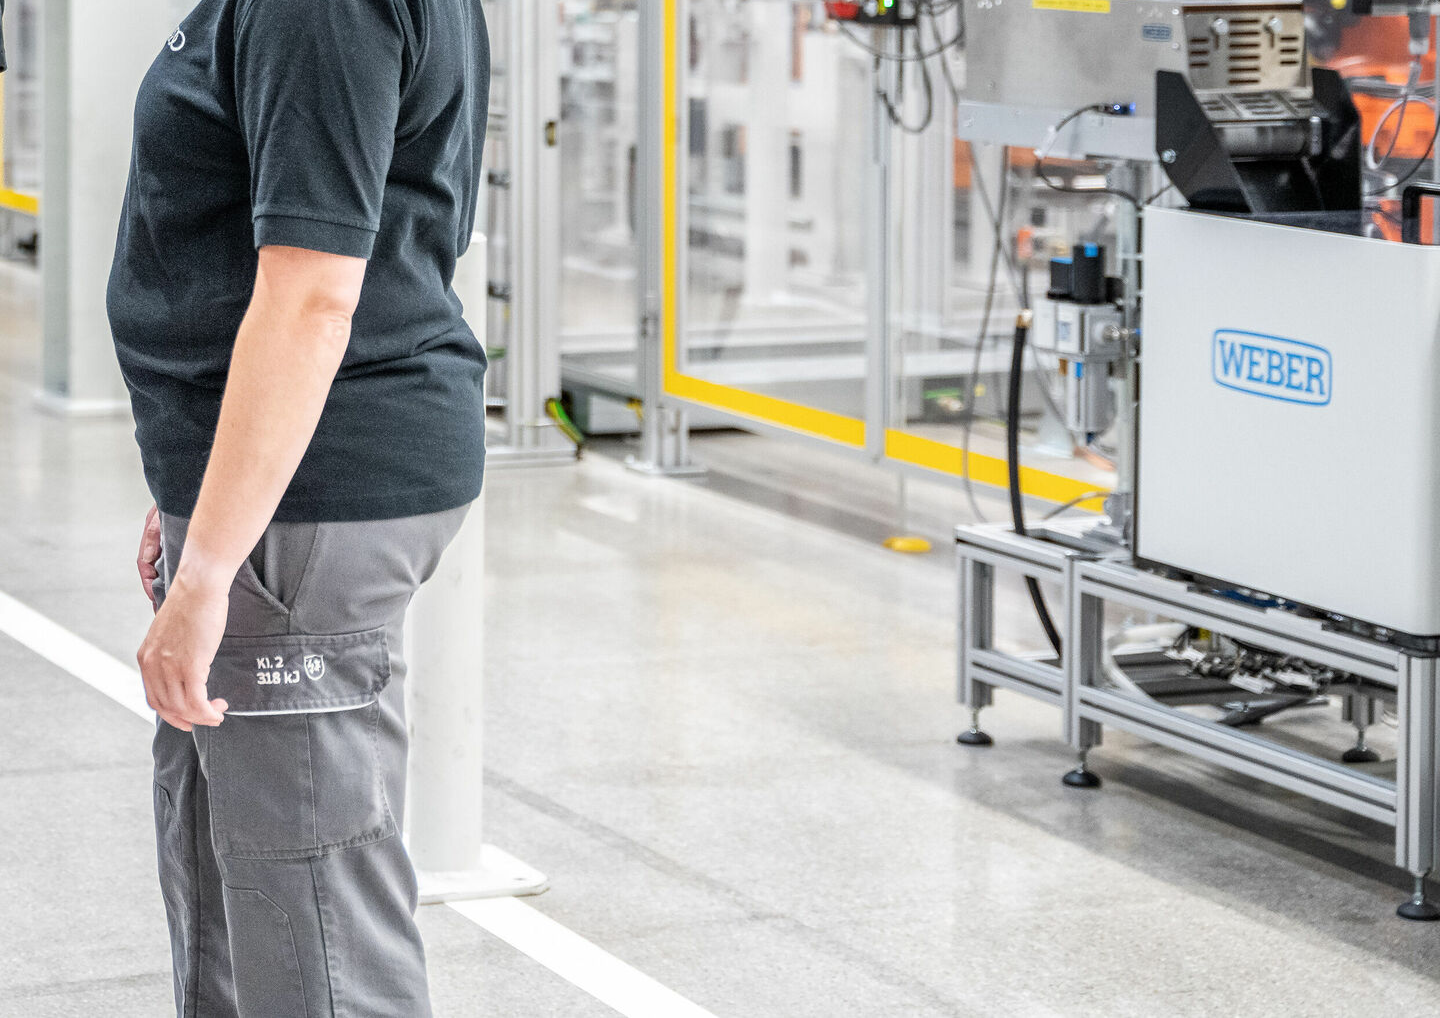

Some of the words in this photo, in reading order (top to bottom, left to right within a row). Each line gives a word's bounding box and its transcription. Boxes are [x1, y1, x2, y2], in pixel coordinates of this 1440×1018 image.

[1219, 340, 1326, 395] WEBER
[274, 656, 284, 668] 2
[256, 672, 281, 685] 318
